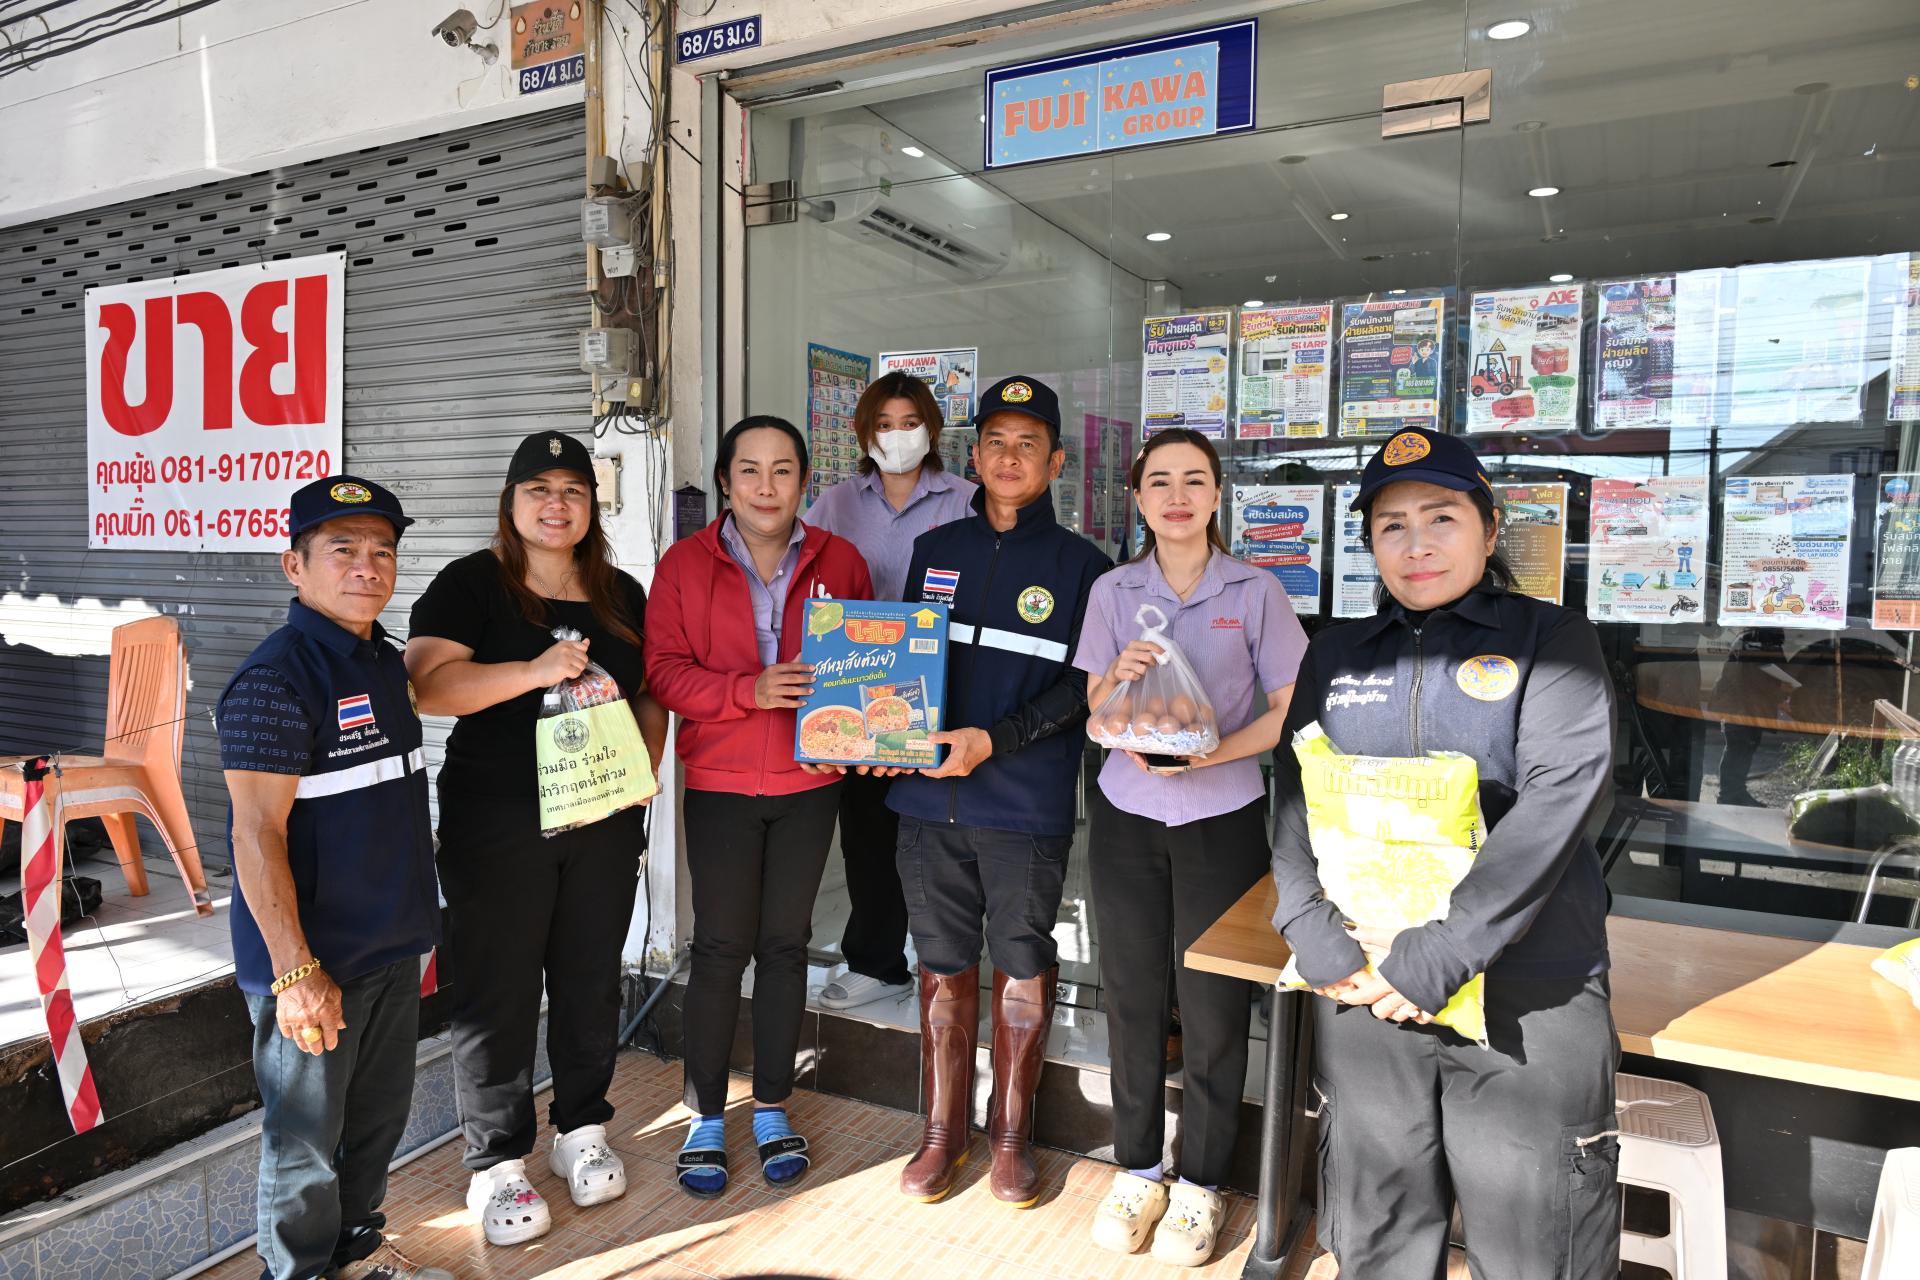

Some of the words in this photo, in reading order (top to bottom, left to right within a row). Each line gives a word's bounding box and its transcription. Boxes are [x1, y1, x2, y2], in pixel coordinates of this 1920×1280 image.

[682, 27, 725, 57] 68/5
[726, 21, 756, 47] ม.6
[522, 65, 557, 91] 68/4
[559, 59, 584, 82] ม.6
[1004, 91, 1086, 137] FUJI
[1103, 71, 1207, 112] KAWA
[1122, 106, 1204, 136] GROUP
[1166, 321, 1202, 335] ฝ่ายผลิต
[1291, 340, 1328, 350] SHARP
[1602, 346, 1649, 359] ฝ่ายผลิต
[98, 274, 328, 437] ขาย
[887, 356, 937, 369] FUJIKAWA
[1604, 357, 1633, 369] หญิง
[96, 452, 155, 493] คุณยุ้ย
[160, 450, 331, 484] 081-9170720
[95, 497, 155, 545] คุณบิ๊ก
[1247, 508, 1305, 520] เปิดรับสมัคร
[1883, 531, 1920, 542] รับสมัค
[251, 714, 278, 725] and
[282, 719, 309, 730] one
[252, 731, 278, 741] you
[259, 746, 288, 758] kiss
[536, 757, 577, 777] ร่วมมือ
[582, 745, 618, 767] ร่วมใจ
